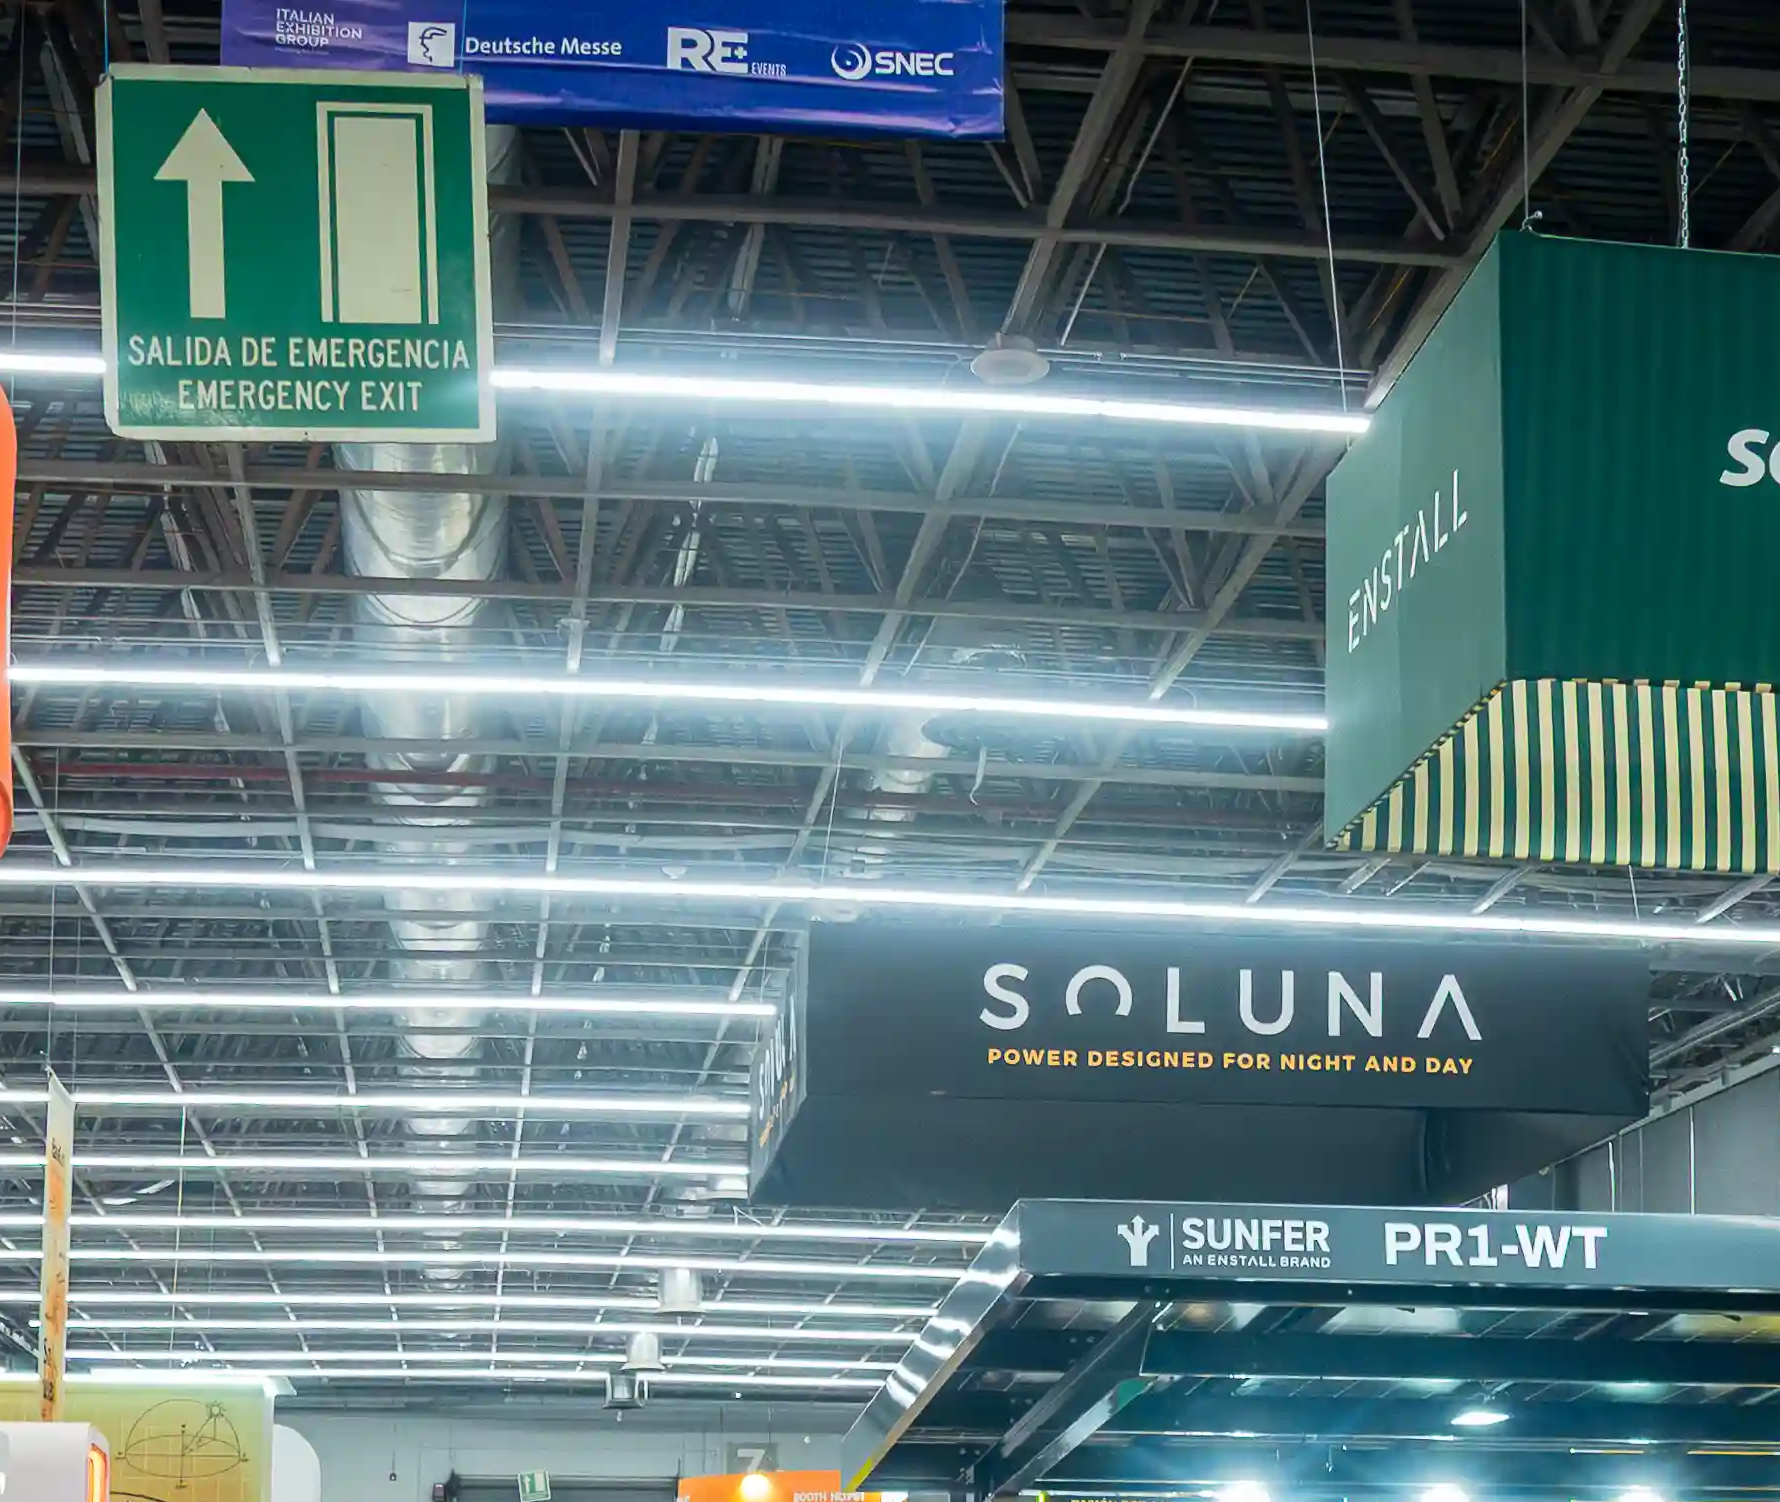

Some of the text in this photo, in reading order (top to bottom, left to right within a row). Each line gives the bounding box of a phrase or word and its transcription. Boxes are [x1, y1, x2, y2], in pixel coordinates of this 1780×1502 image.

[276, 8, 335, 26] ITALIAN
[275, 21, 363, 40] EXHIBITION
[275, 33, 330, 49] GROUP
[465, 36, 622, 56] Deutsche Messe
[751, 62, 787, 77] EVENTS
[874, 52, 955, 77] SNEC
[127, 335, 471, 371] SALIDA DE EMERGENCIA
[176, 379, 425, 413] EMERGENCY EXIT
[987, 1047, 1474, 1076] POWER DESIGNED FOR NIGHT AND DAY
[1181, 1217, 1330, 1254] SUNFER
[1383, 1221, 1609, 1270] PR1-WT
[1181, 1253, 1331, 1269] AN ENSTALL BRAND
[736, 1448, 766, 1475] 7
